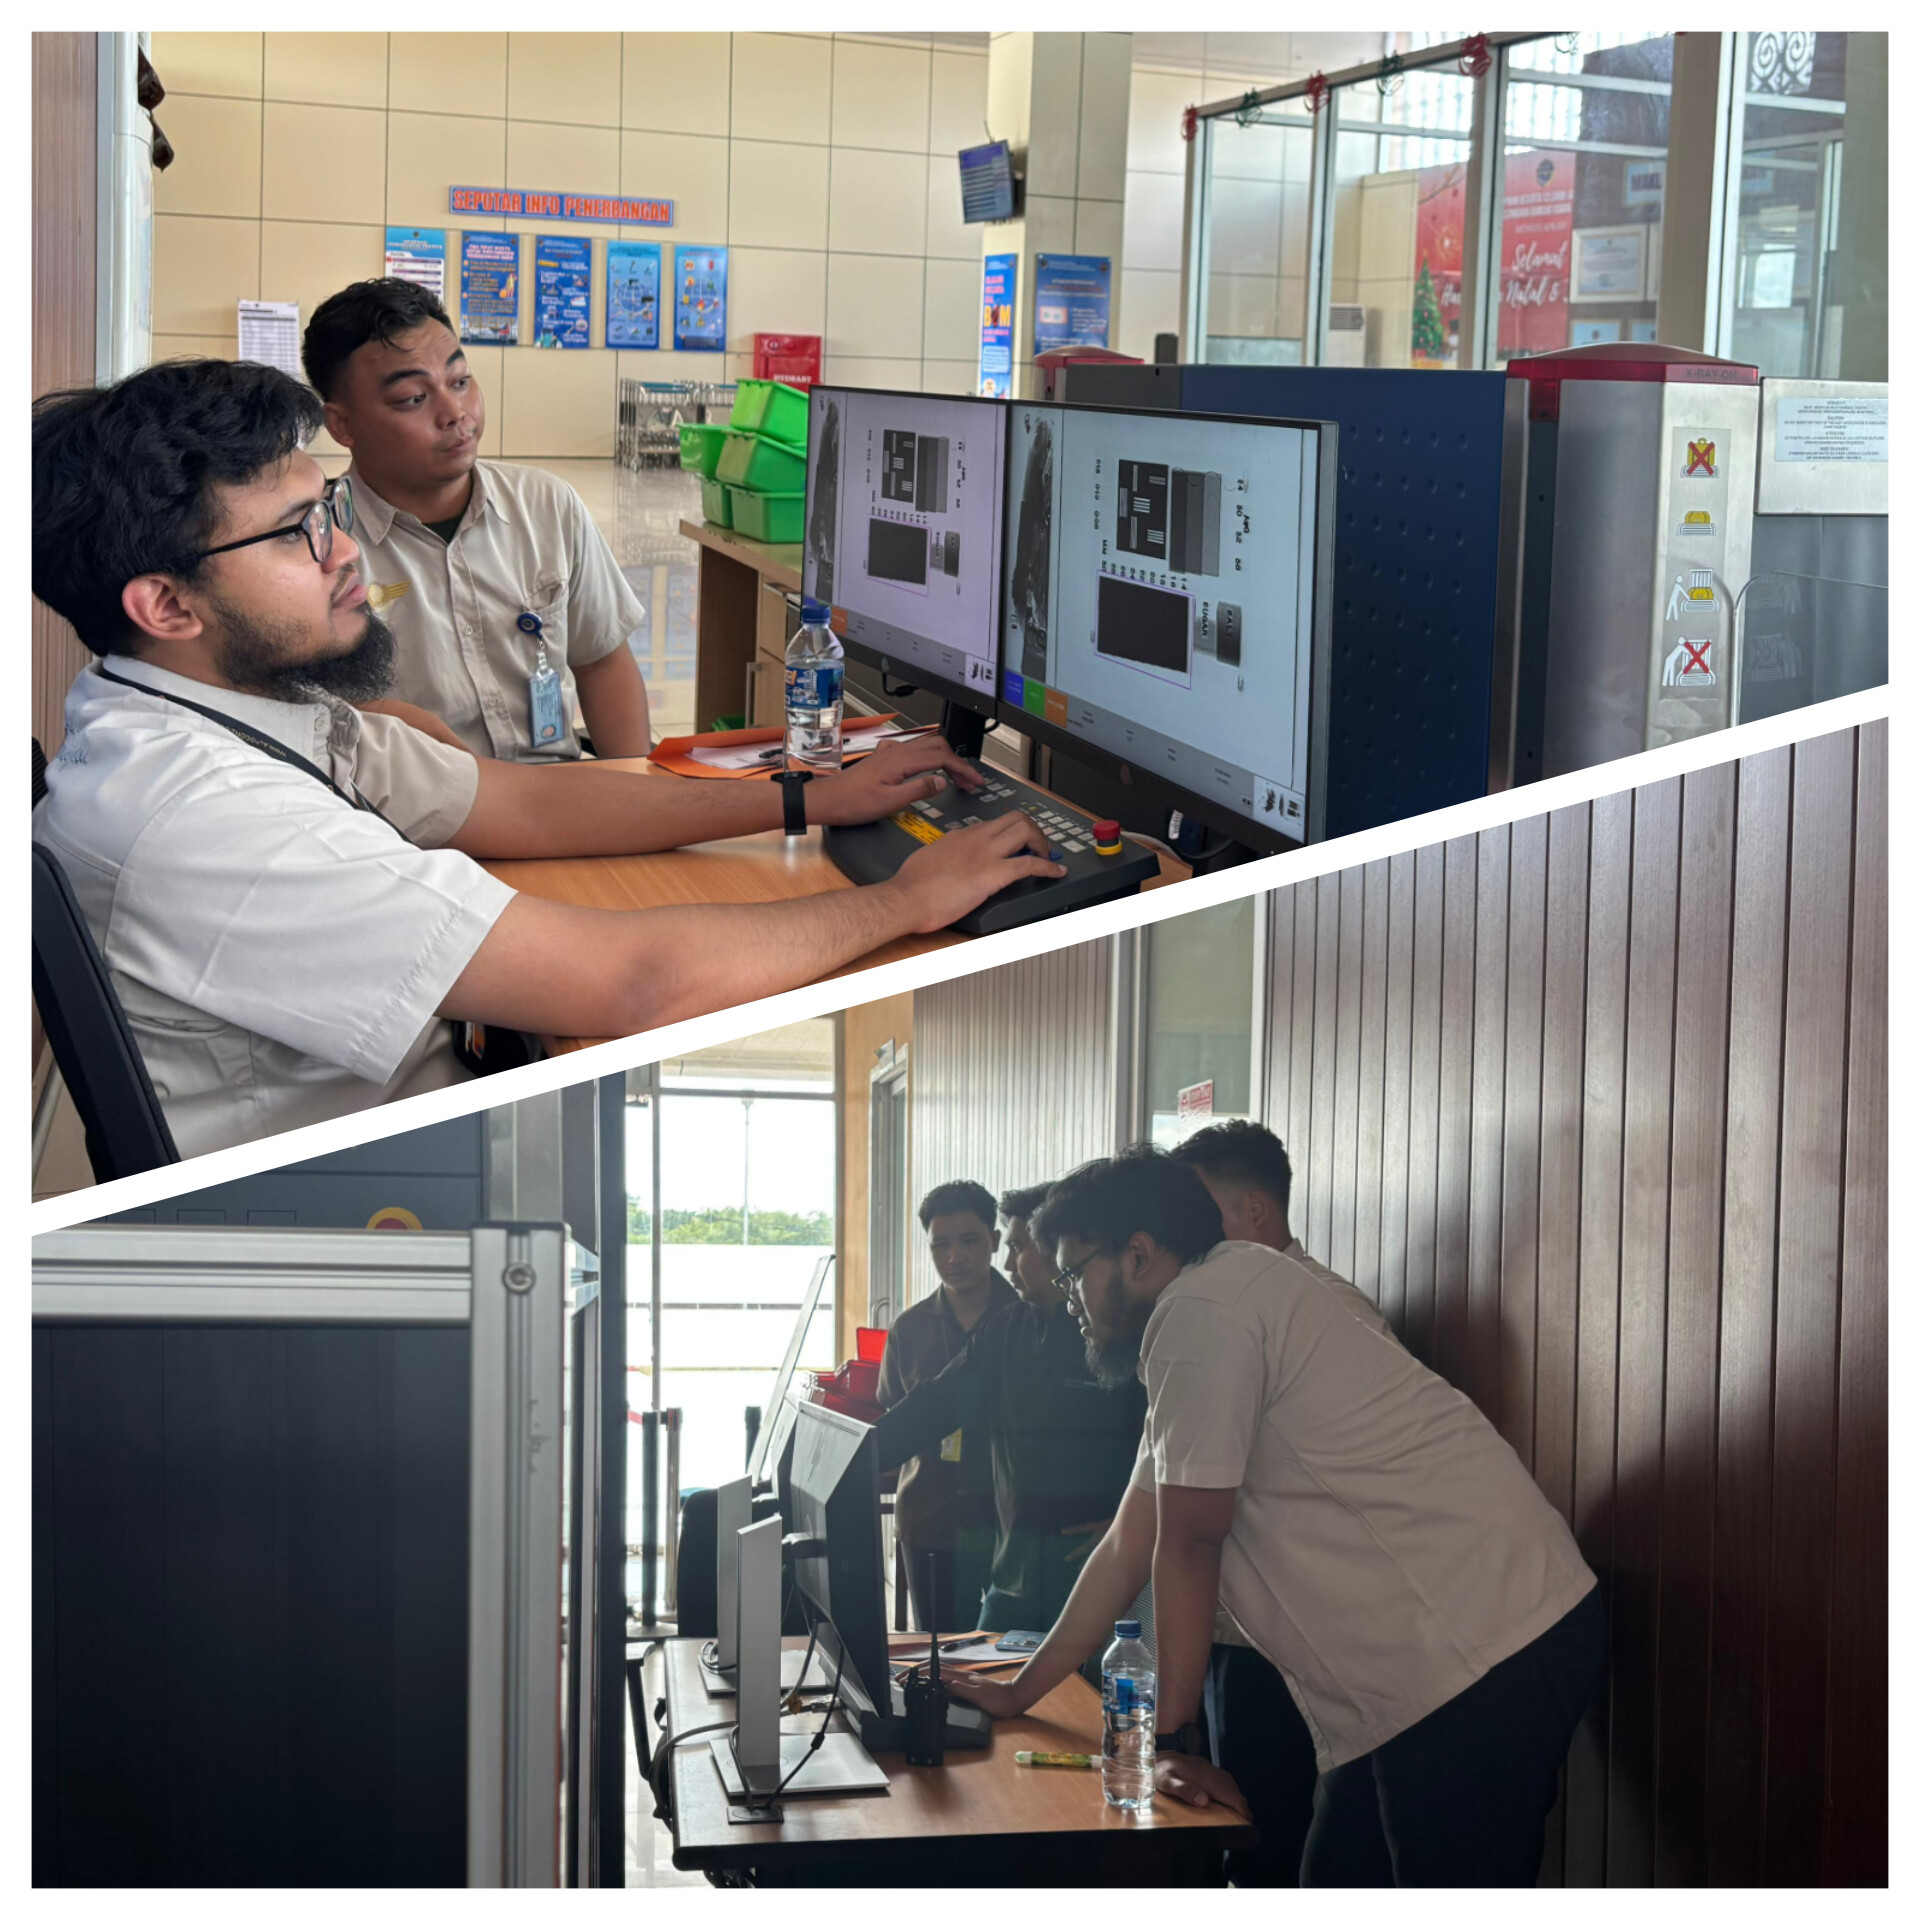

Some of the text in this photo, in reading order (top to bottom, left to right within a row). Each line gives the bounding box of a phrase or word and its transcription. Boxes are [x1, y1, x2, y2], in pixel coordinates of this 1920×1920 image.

[453, 190, 670, 222] SEPUTAR INFO PENERBANGAN
[1511, 239, 1569, 272] Selamat
[1505, 273, 1548, 309] Natal
[1684, 368, 1737, 380] X-RAY ON
